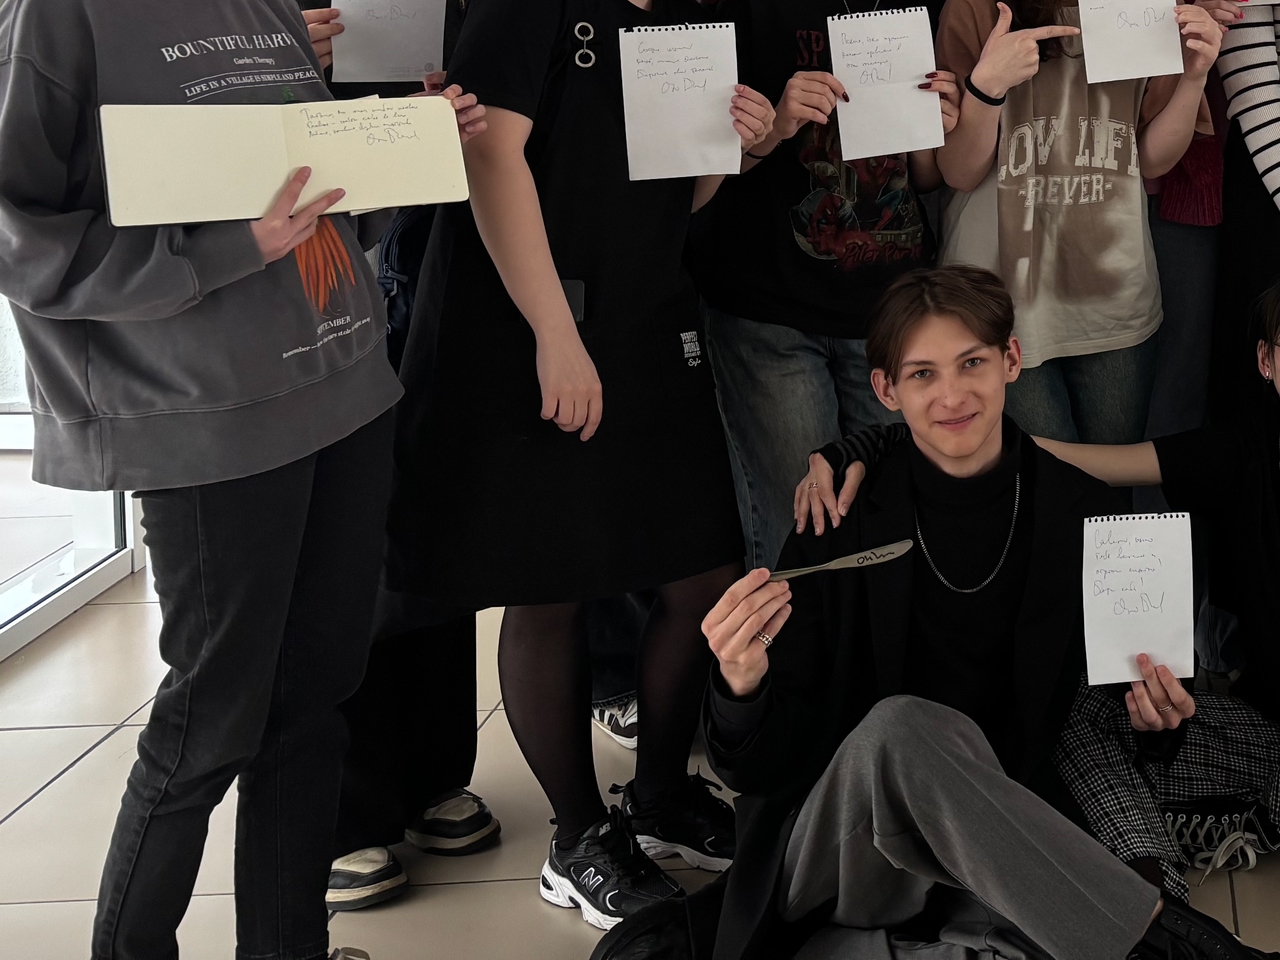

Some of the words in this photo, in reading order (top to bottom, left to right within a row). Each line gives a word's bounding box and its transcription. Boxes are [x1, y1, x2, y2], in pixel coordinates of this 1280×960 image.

[161, 34, 253, 63] BOUNTIFUL
[252, 32, 299, 49] HARV
[233, 56, 254, 66] Garden
[253, 56, 275, 65] Therapy
[185, 83, 210, 97] LIFE
[208, 80, 220, 89] IN
[221, 79, 227, 87] A
[226, 76, 255, 84] VILLAGE
[294, 70, 318, 79] PEAC
